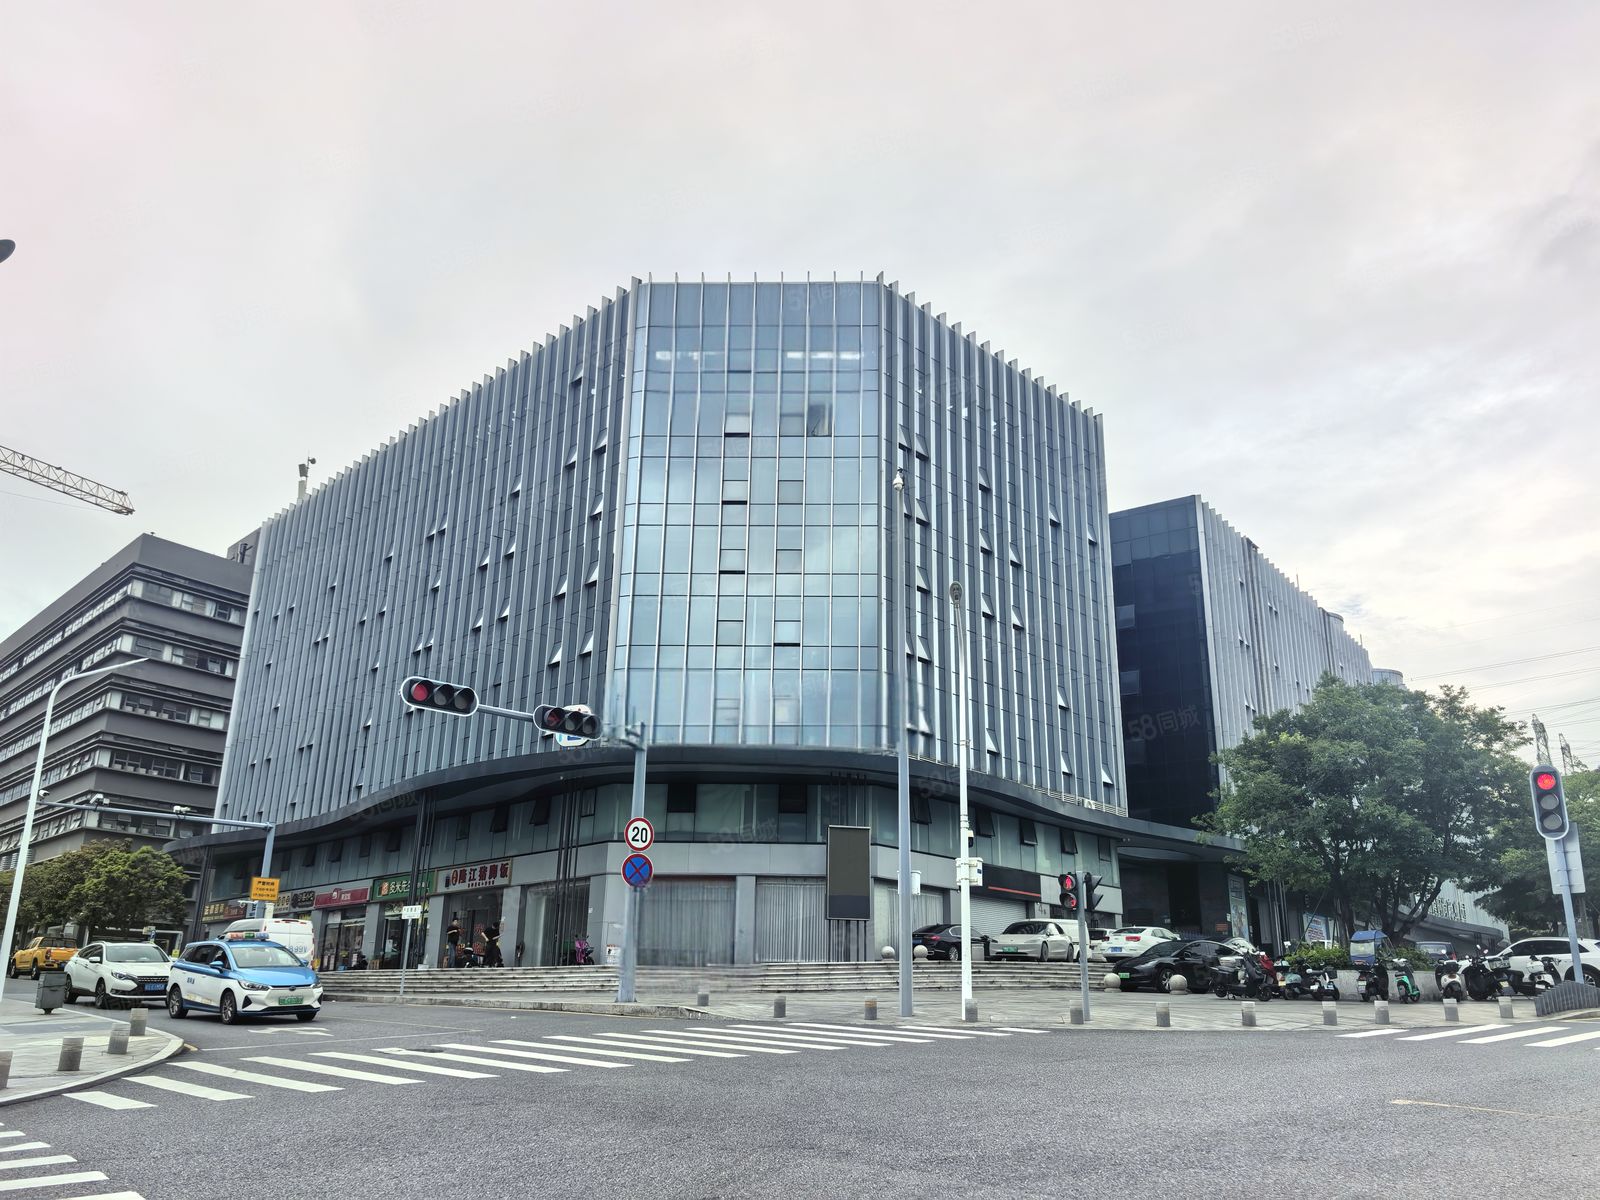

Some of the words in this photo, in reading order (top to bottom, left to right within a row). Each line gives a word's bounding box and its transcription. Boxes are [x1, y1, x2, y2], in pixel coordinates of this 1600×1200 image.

[631, 826, 648, 844] 20
[458, 862, 509, 885] 隆江猪脚饭
